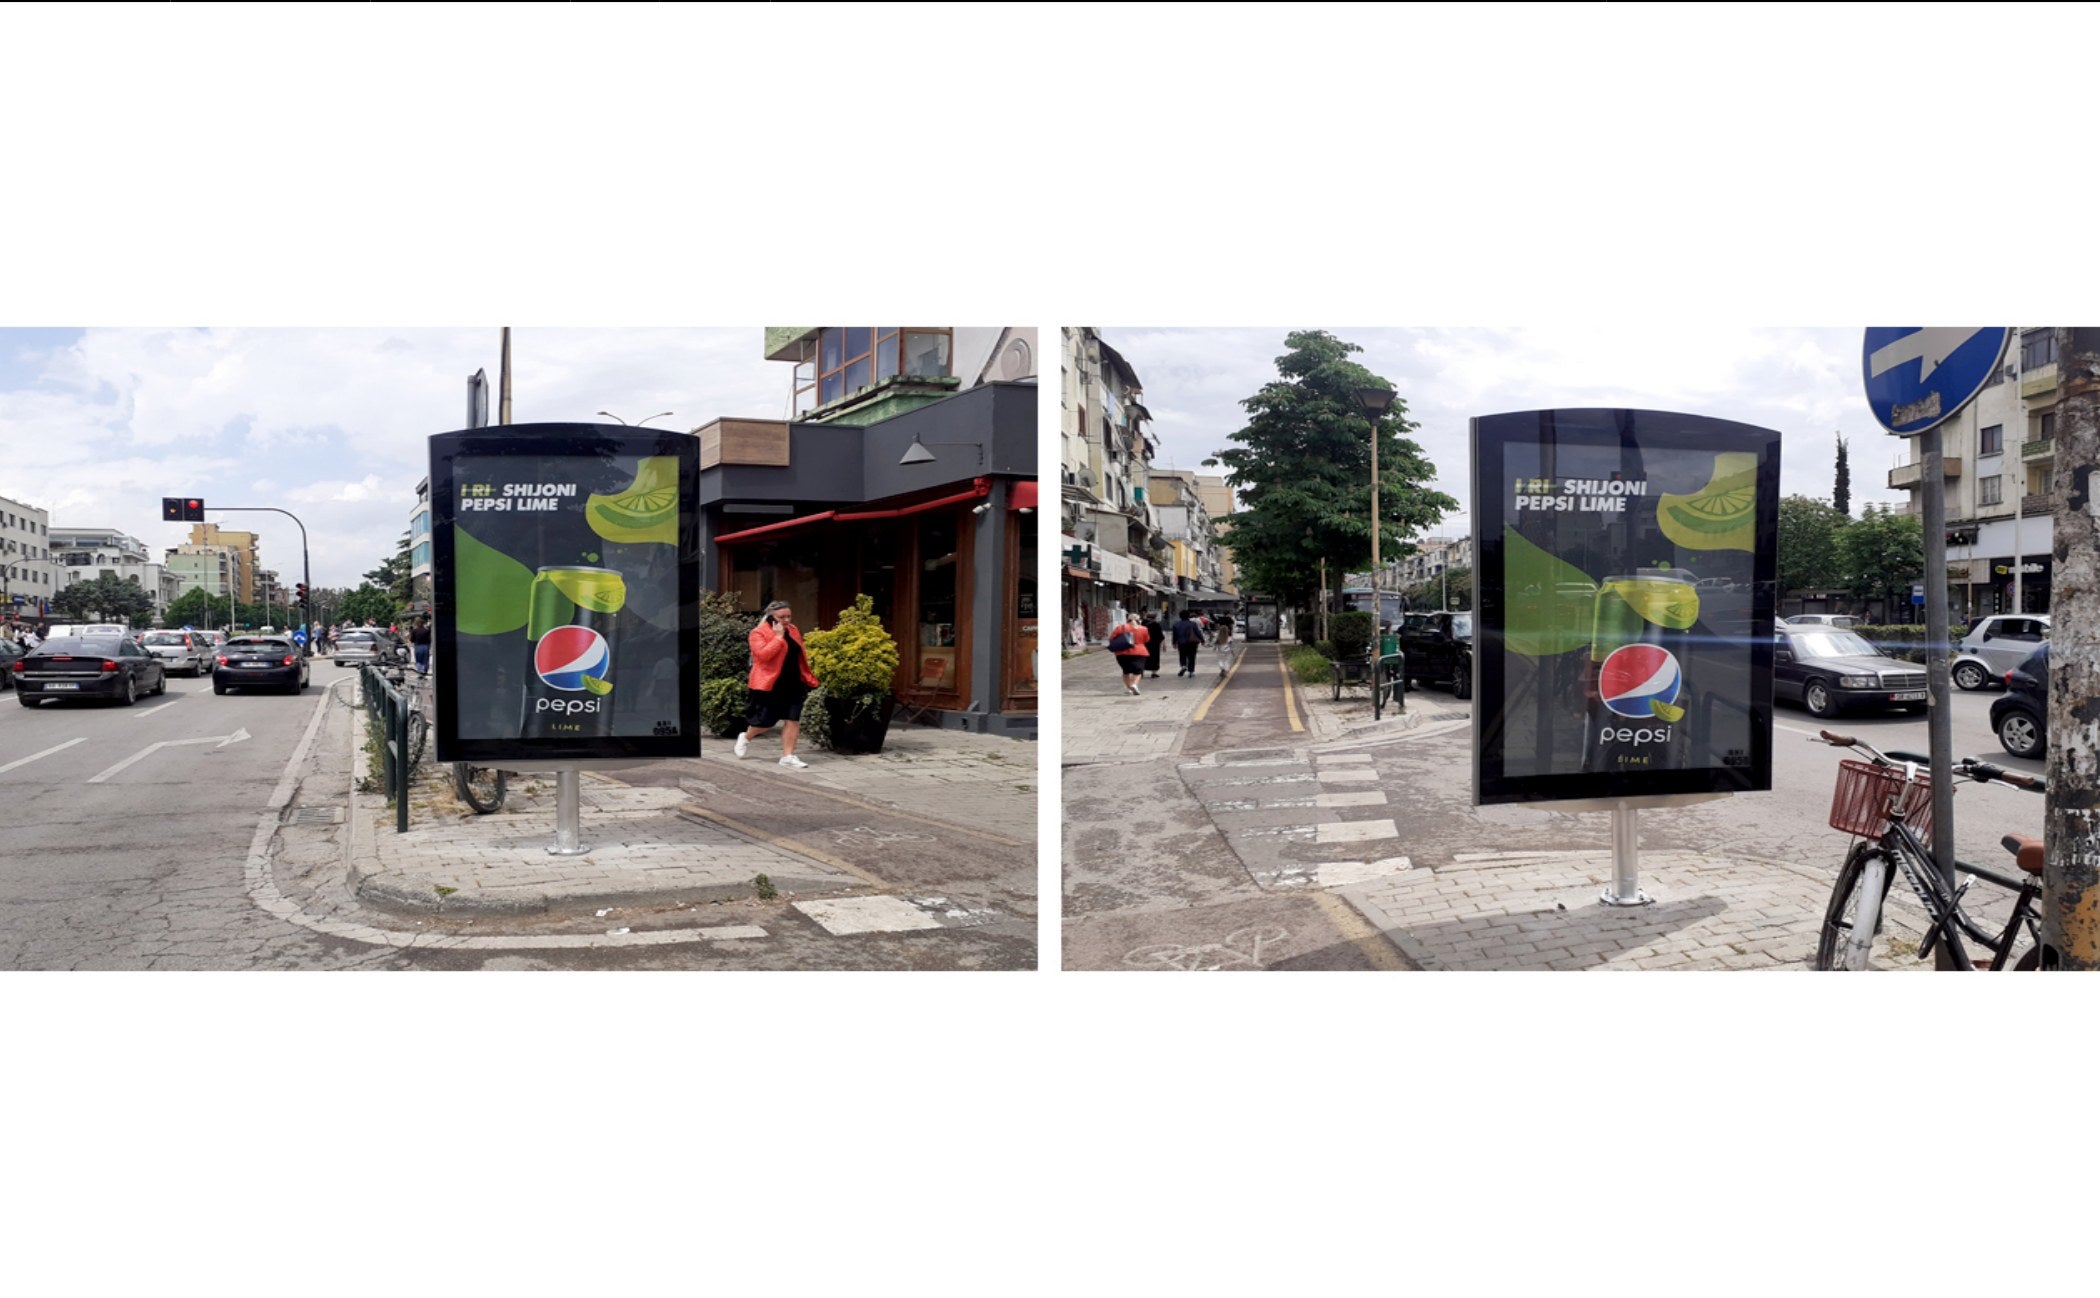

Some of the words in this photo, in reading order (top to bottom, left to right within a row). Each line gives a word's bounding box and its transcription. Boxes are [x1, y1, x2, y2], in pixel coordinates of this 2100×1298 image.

[502, 483, 576, 497] SHIJONI
[1564, 479, 1647, 496] SHIJONI
[461, 498, 512, 511] PEPSI
[517, 498, 558, 511] LIME
[1515, 495, 1574, 511] PEPSI
[1580, 496, 1627, 512] LIME
[535, 697, 600, 716] pepsi
[552, 723, 580, 731] LIME
[1599, 725, 1672, 747] pepsi
